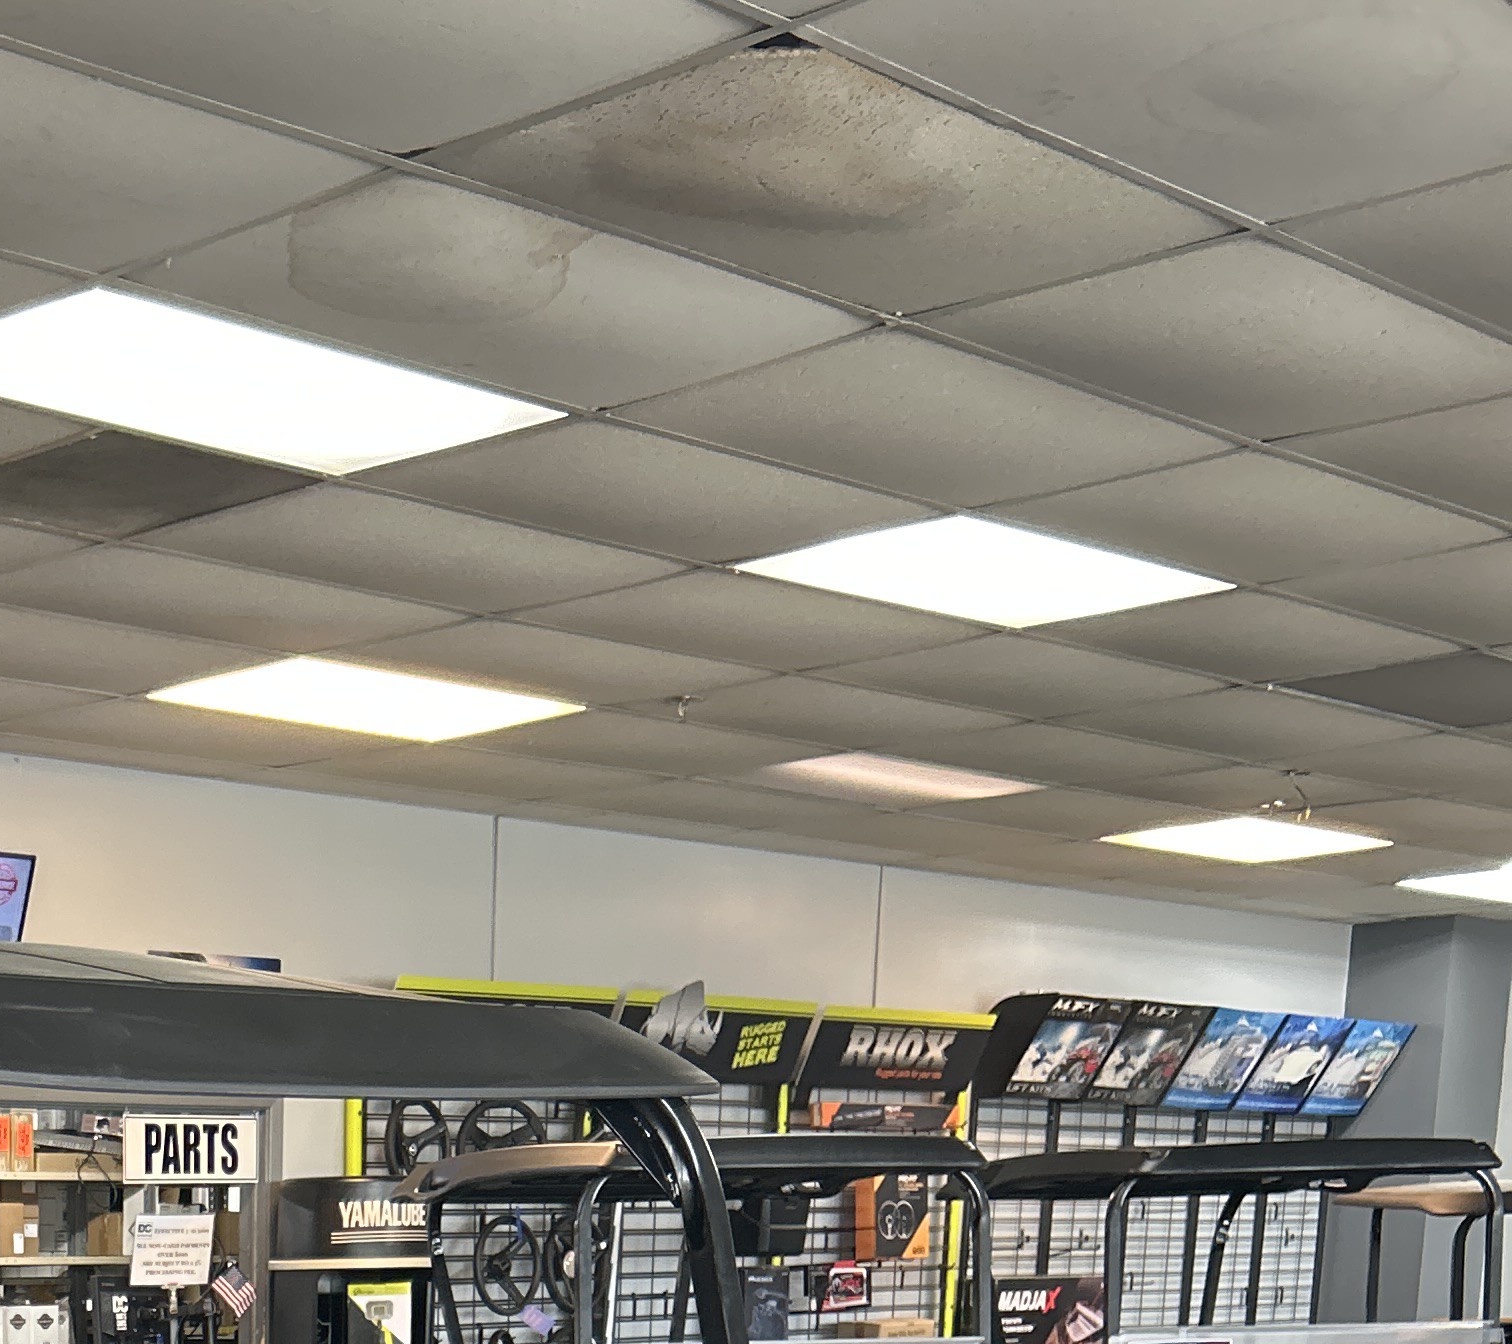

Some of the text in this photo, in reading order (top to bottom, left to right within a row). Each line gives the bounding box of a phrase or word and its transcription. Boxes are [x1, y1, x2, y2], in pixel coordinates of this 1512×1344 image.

[737, 1033, 783, 1051] STARTS
[740, 1020, 786, 1039] RUGGED
[731, 1046, 781, 1070] HERE
[841, 1024, 958, 1070] RHOX
[144, 1123, 239, 1175] PARTS
[338, 1200, 426, 1228] YAMALUBE
[998, 1286, 1062, 1314] MADJAX
